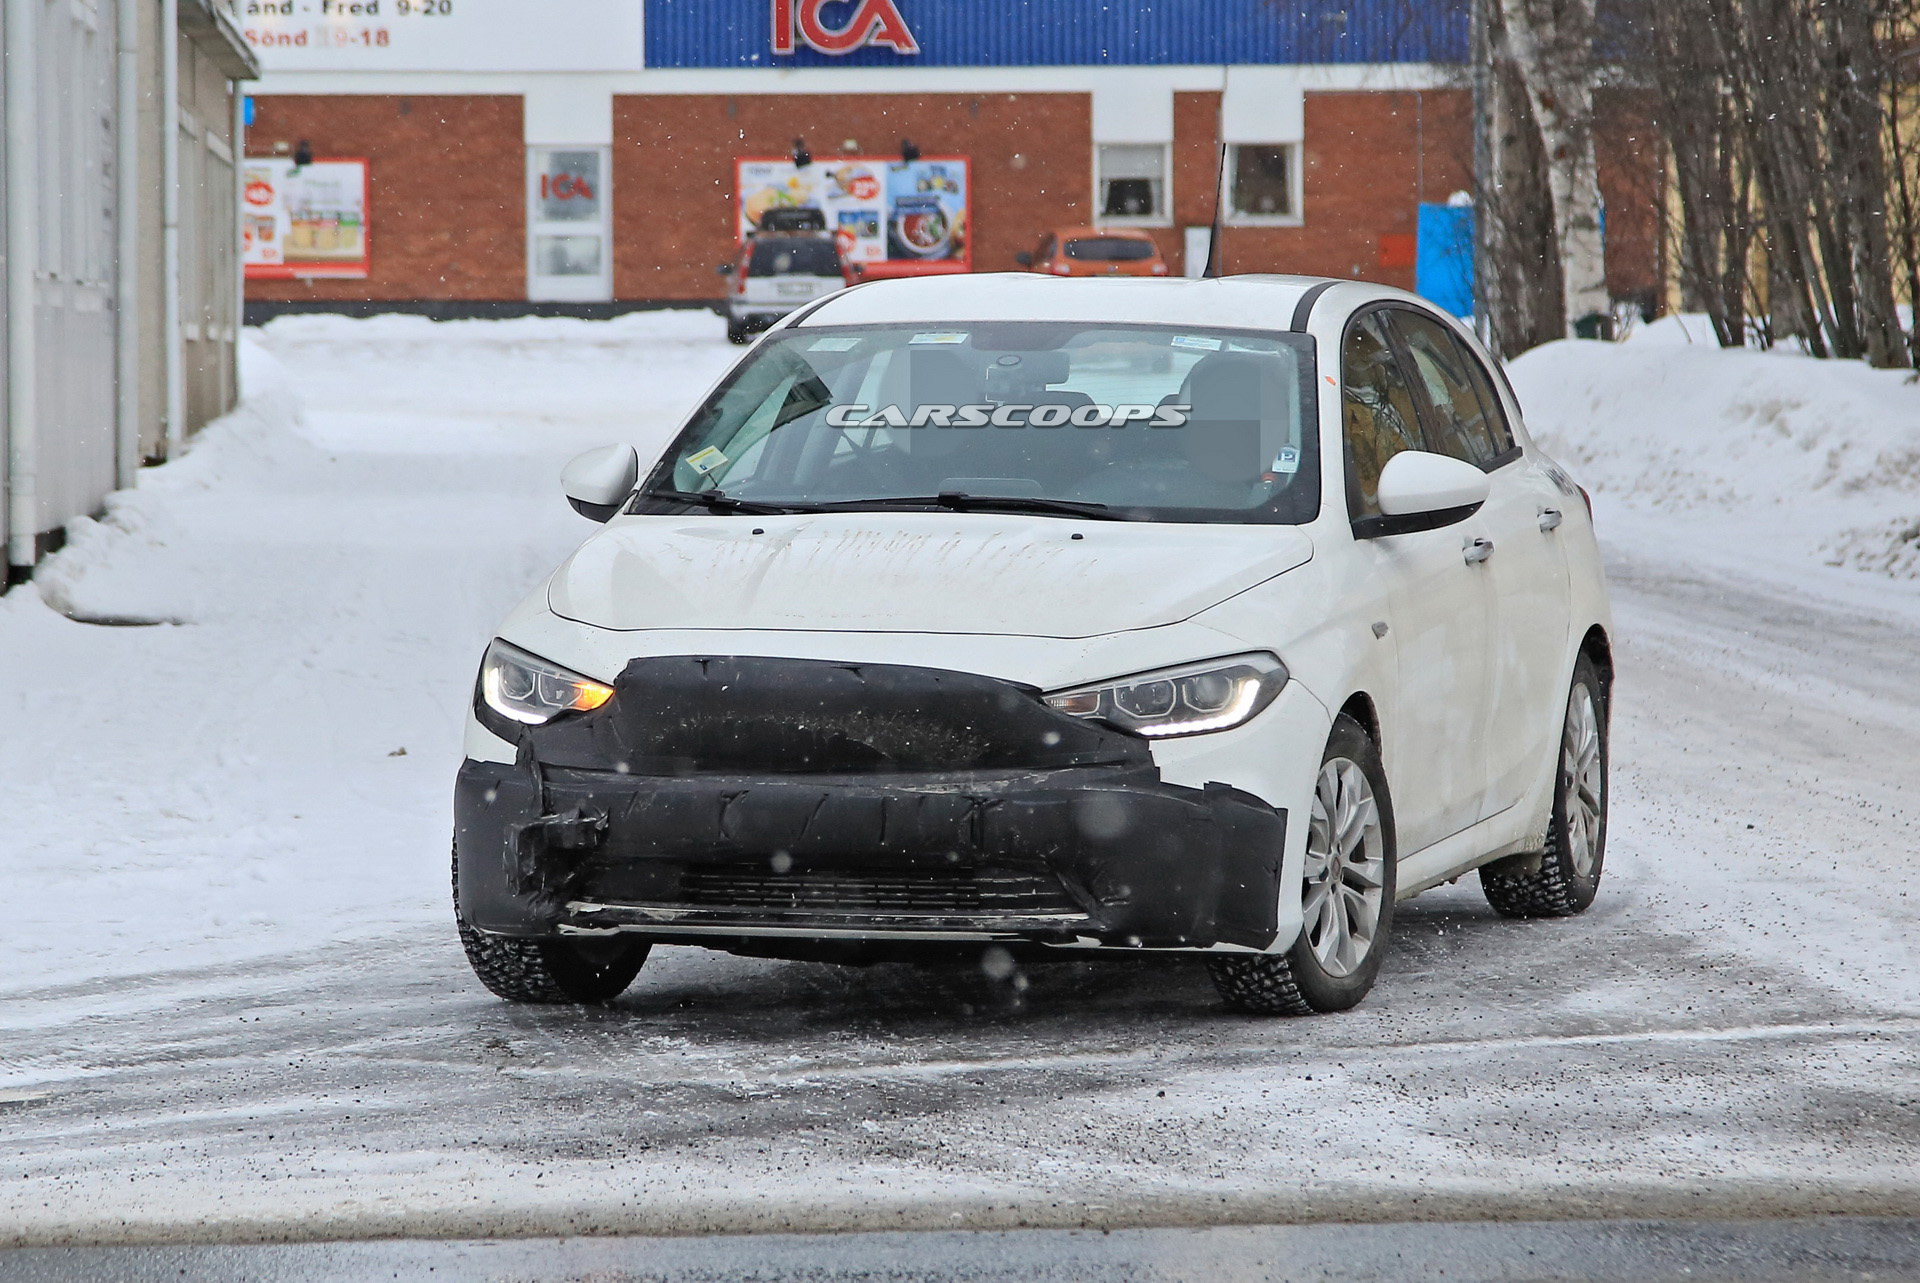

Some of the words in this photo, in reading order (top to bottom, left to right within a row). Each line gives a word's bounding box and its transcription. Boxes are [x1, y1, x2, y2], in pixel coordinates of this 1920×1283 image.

[321, 0, 379, 16] Fred
[244, 28, 308, 47] Sönd
[771, 0, 921, 55] ICA
[541, 174, 594, 200] ICA
